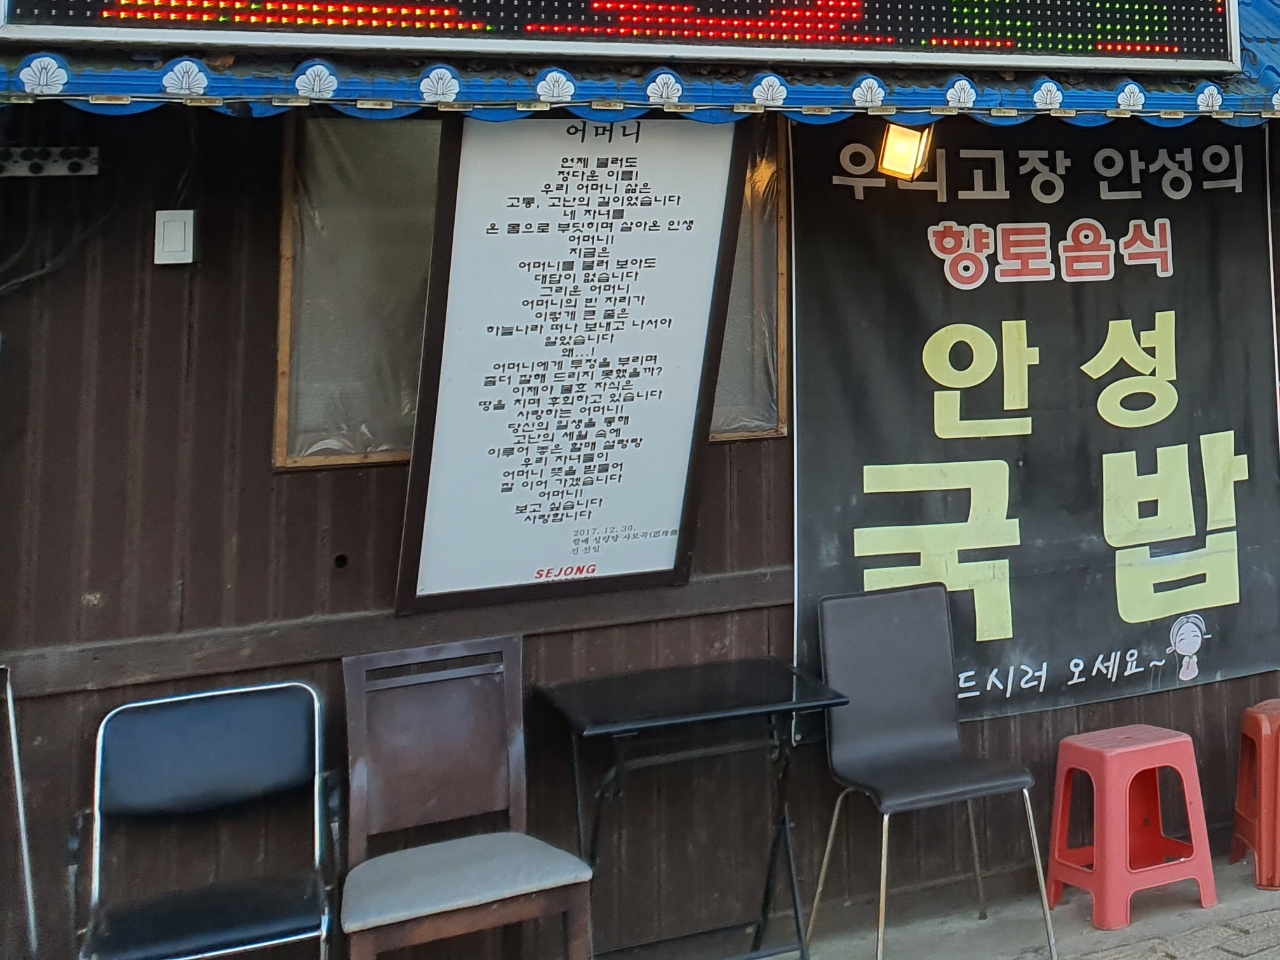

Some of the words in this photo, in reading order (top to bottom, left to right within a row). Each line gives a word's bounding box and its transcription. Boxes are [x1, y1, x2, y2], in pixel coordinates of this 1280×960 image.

[566, 121, 641, 144] 어머니
[561, 157, 589, 169] 언제
[558, 170, 599, 182] 정다운
[1093, 144, 1244, 201] 안성의
[541, 183, 569, 194] 우리
[576, 183, 618, 194] 어머니
[548, 196, 590, 208] 고난의
[485, 223, 499, 235] 온
[620, 220, 661, 232] 살아온
[667, 219, 694, 232] 인생
[569, 247, 610, 259] 지금은
[927, 217, 1175, 291] 향토음식
[616, 258, 657, 269] 보아도
[534, 273, 576, 285] 대답이
[540, 285, 581, 297] 그리운
[589, 284, 630, 295] 어머니
[521, 298, 577, 310] 어머니의
[604, 295, 646, 307] 자리가
[632, 318, 673, 330] 나서야
[593, 380, 634, 392] 자식은
[516, 407, 572, 421] 사랑하는
[507, 421, 550, 434] 당신의
[513, 432, 555, 445] 고난의
[520, 456, 549, 468] 우리
[502, 467, 544, 481] 어머니
[521, 479, 548, 491] 이어
[514, 502, 542, 514] 보고
[534, 563, 597, 580] SEJONG
